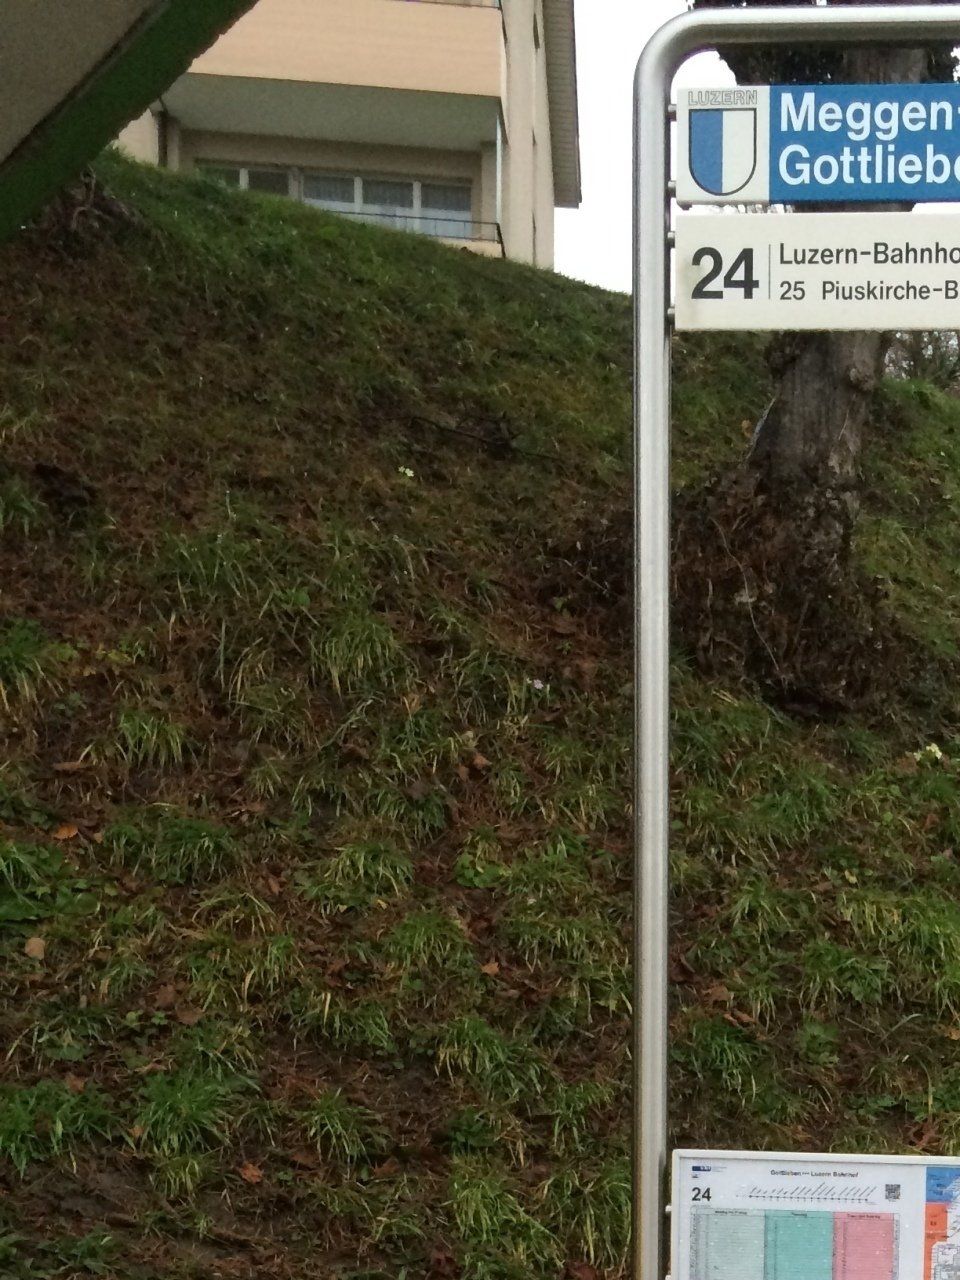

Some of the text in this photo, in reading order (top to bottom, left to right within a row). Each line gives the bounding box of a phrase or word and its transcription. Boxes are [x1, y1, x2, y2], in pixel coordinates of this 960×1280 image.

[687, 90, 757, 106] LUZERN
[691, 247, 759, 299] 24
[779, 281, 806, 300] 25
[691, 1186, 712, 1202] 24
